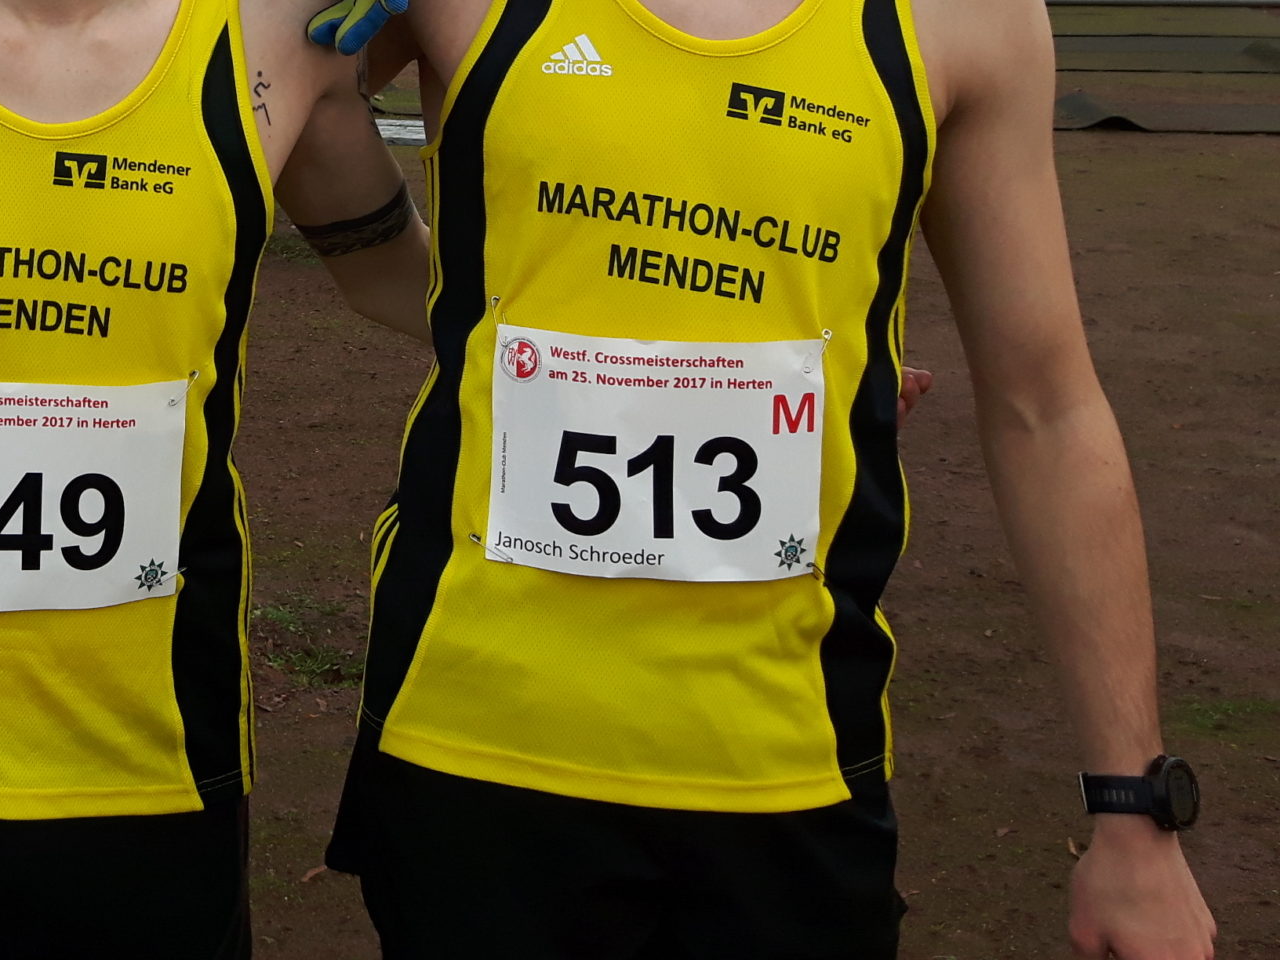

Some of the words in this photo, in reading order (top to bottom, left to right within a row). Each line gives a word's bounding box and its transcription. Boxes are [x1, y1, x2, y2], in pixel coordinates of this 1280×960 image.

[542, 59, 613, 77] adidas
[790, 96, 871, 128] Mendener
[788, 115, 827, 137] Bank
[831, 129, 853, 144] eG
[112, 157, 192, 177] Mendener
[111, 177, 149, 193] Bank
[153, 181, 174, 195] eG
[537, 181, 841, 264] MARATHON-CLUB
[607, 243, 765, 304] MENDEN
[550, 346, 591, 362] Westf.
[594, 351, 744, 369] Crossmeisterschaften
[548, 369, 568, 380] am
[571, 370, 592, 383] 25.
[596, 373, 669, 388] November
[673, 377, 706, 389] 2017
[710, 377, 723, 389] in
[727, 378, 773, 390] Herten
[42, 416, 73, 428] 2017
[77, 417, 89, 428] in
[92, 418, 136, 429] Herten
[772, 392, 816, 435] M
[551, 430, 762, 541] 513
[494, 531, 563, 558] Janosch
[568, 540, 665, 566] Schroeder
